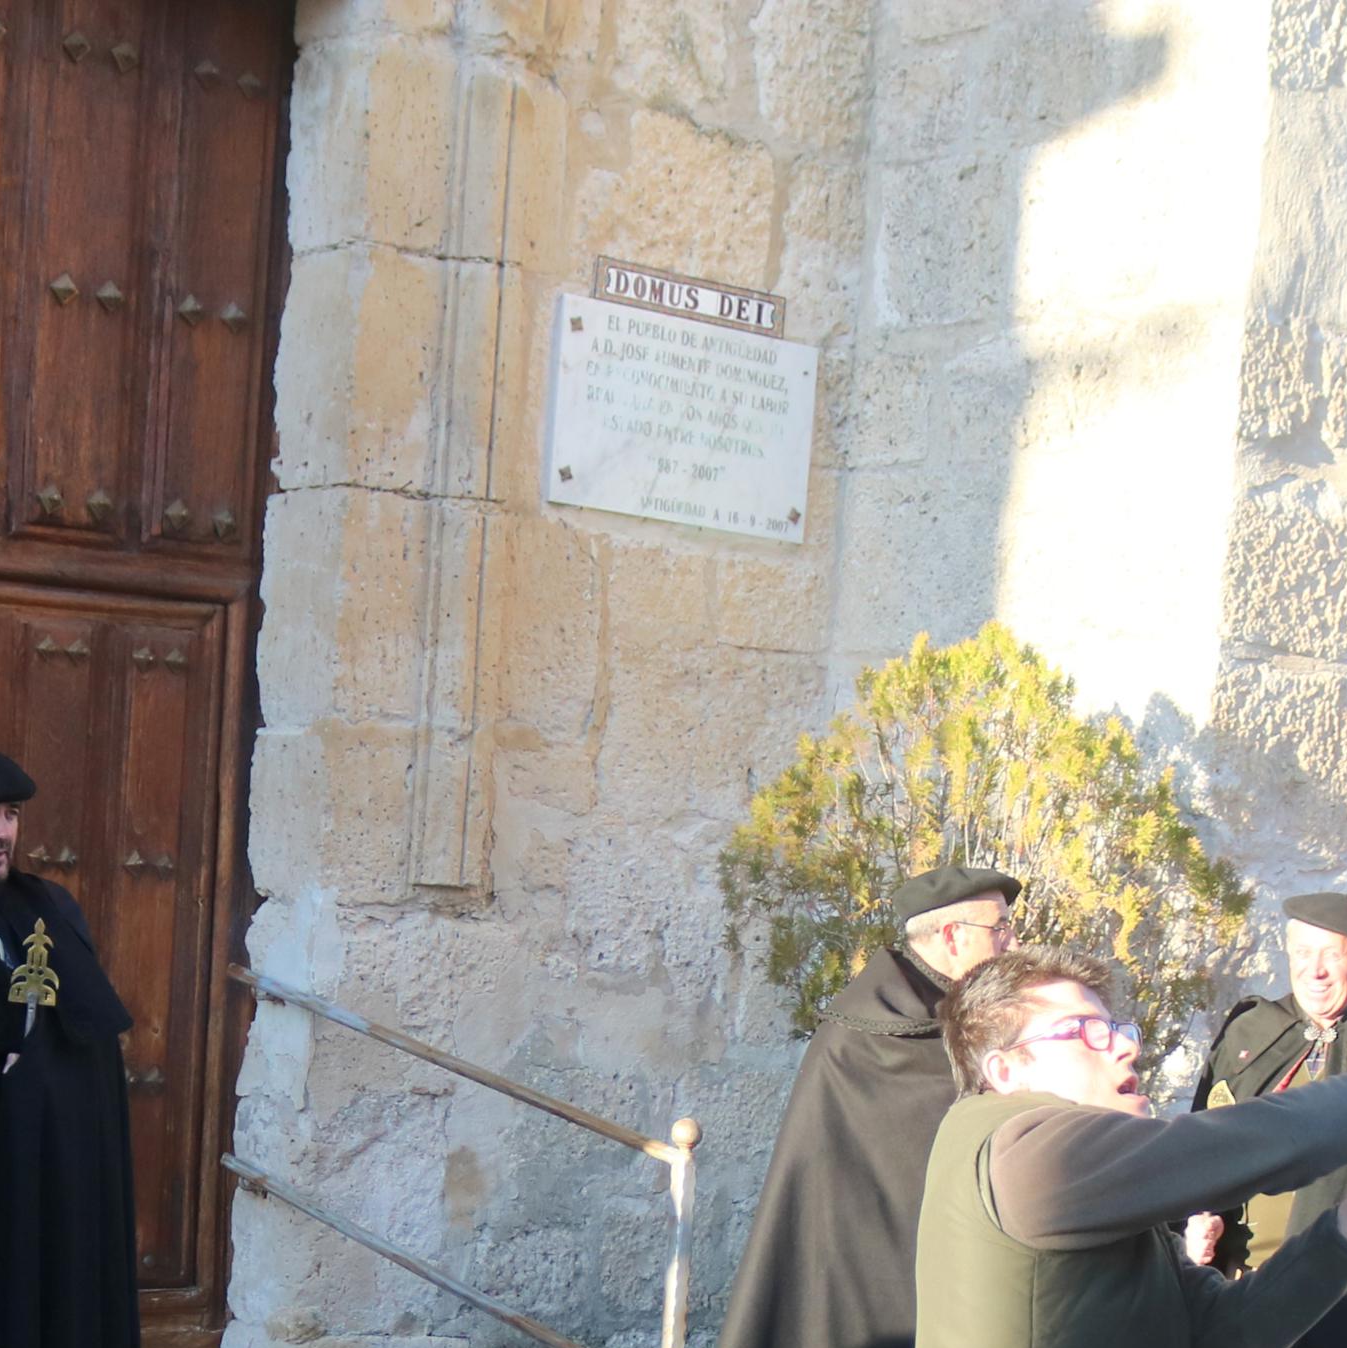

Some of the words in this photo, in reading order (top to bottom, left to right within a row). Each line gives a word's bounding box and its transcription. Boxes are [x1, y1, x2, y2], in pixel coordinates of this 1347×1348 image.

[614, 270, 700, 310] DOMUS
[718, 294, 765, 325] DEI
[591, 336, 599, 353] A
[607, 314, 622, 332] EL
[627, 318, 677, 343] PUEBLO
[680, 329, 697, 348] DE
